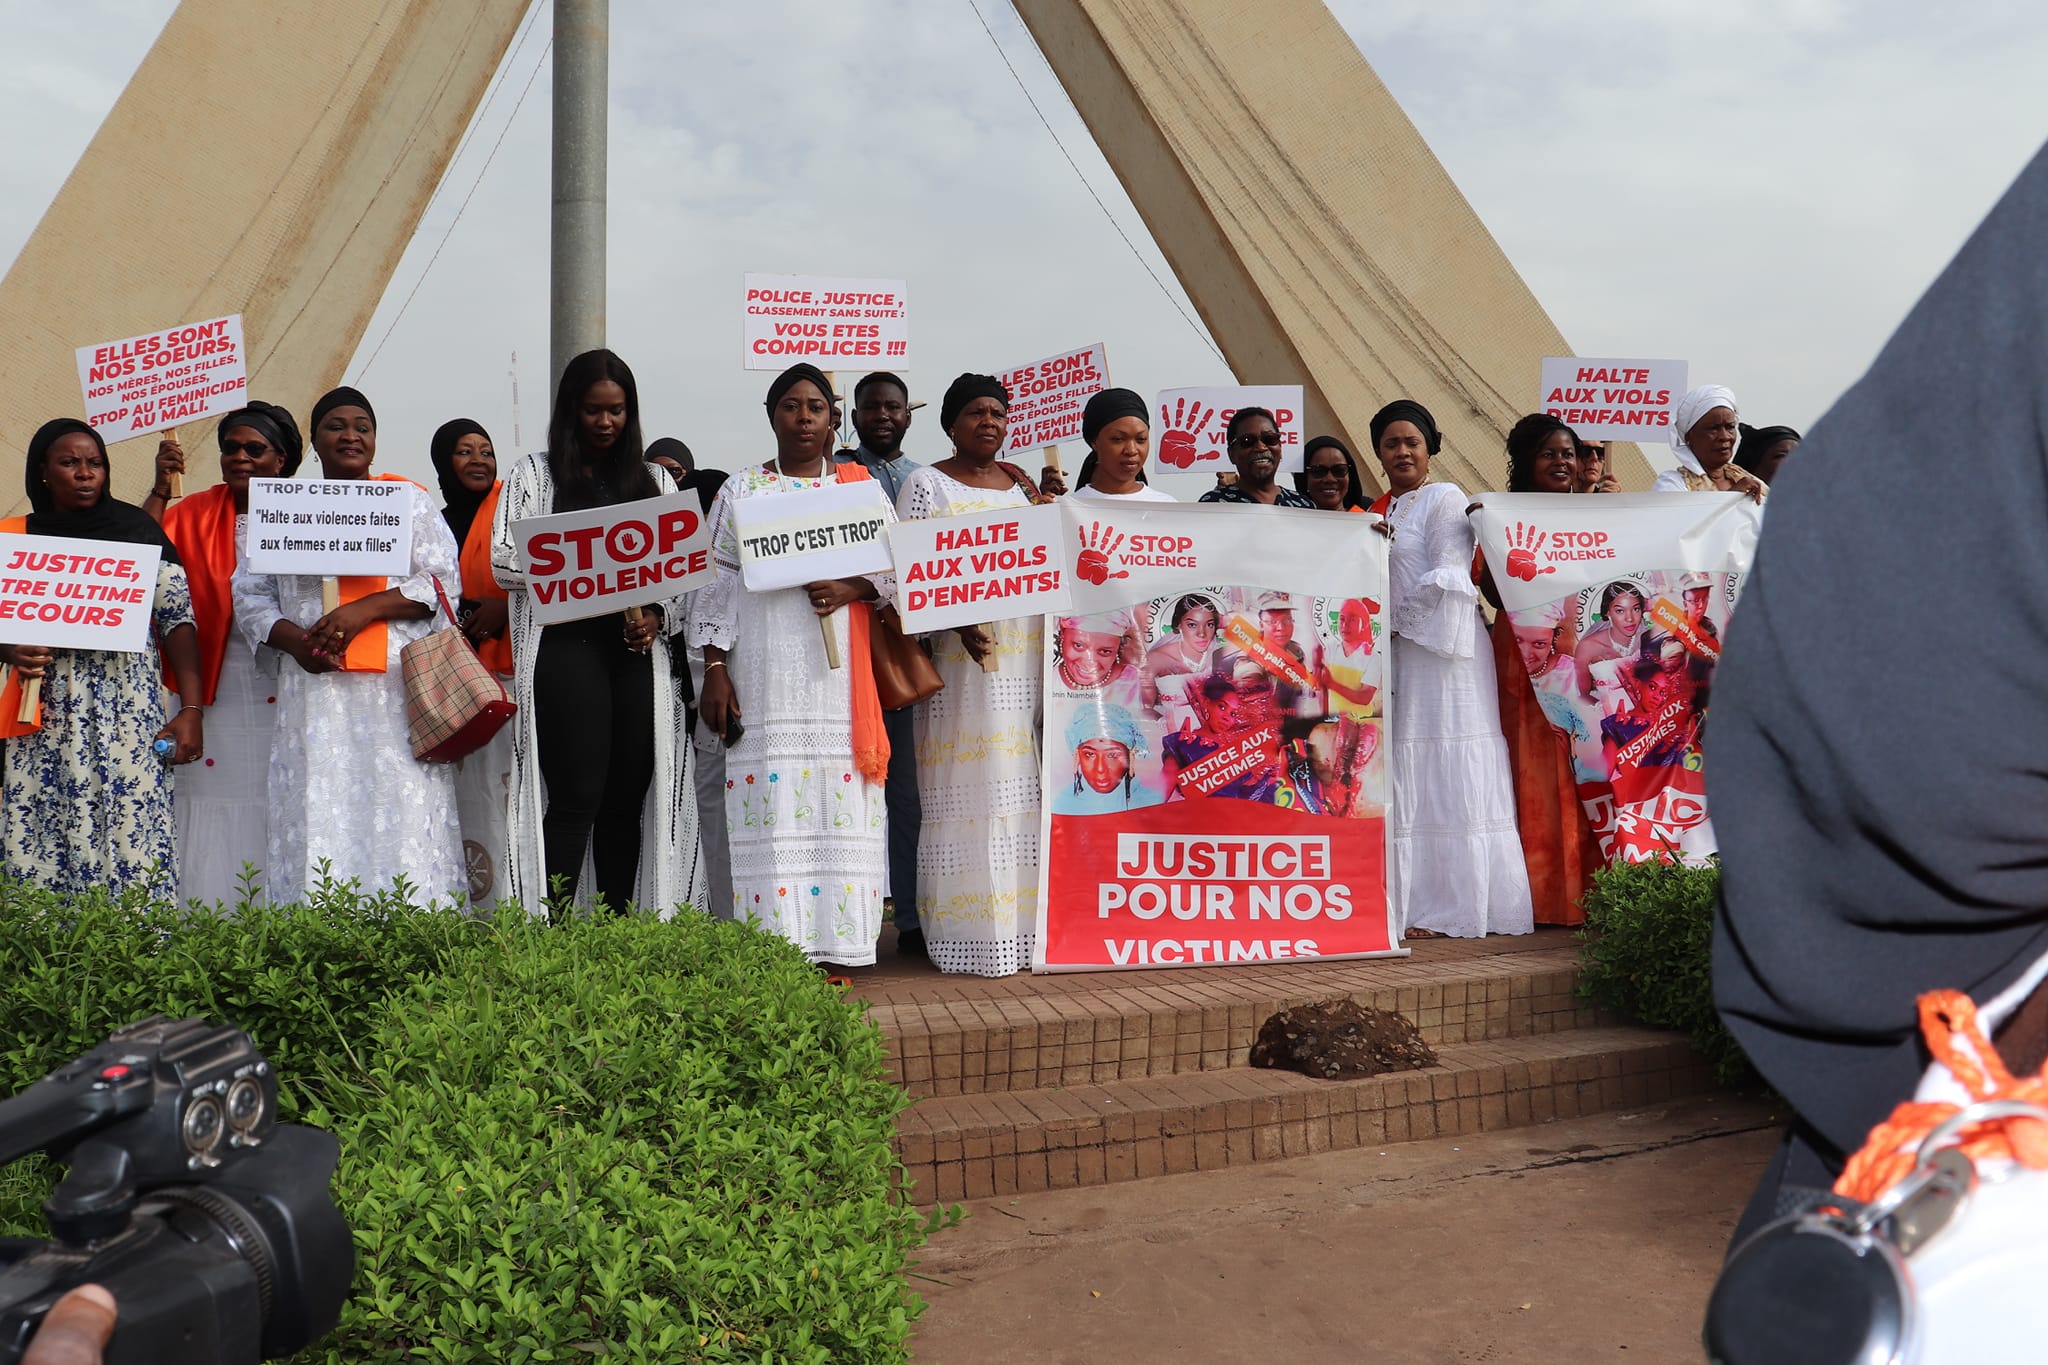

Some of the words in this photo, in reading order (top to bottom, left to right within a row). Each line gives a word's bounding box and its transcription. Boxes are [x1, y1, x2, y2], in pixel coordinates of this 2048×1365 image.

[747, 289, 812, 303] POLICE
[823, 292, 894, 305] JUSTICE
[748, 306, 826, 316] CLASSEMENT
[829, 309, 861, 317] SANS
[864, 309, 898, 318] SUITE
[95, 336, 160, 365] ELLES
[167, 320, 228, 348] SONT
[775, 323, 827, 337] VOUS
[833, 325, 879, 338] ETES
[89, 359, 135, 383] NOS
[142, 336, 236, 370] SOEURS,
[753, 339, 880, 355] COMPLICES
[88, 385, 114, 399] NOS
[117, 374, 162, 392] MÈRES,
[165, 366, 191, 380] NOS
[195, 355, 237, 372] FILLES,
[1003, 367, 1035, 387] LES
[1041, 351, 1093, 377] SONT
[1020, 365, 1101, 398] SOEURS,
[1576, 368, 1649, 383] HALTE
[122, 390, 146, 403] NOS
[151, 374, 210, 395] ÉPOUSES,
[1040, 393, 1062, 405] NOS
[1547, 388, 1597, 403] AUX
[1603, 389, 1670, 405] VIOLS
[90, 408, 128, 428] STOP
[132, 400, 154, 417] AU
[158, 377, 246, 409] FEMINICIDE
[131, 413, 156, 430] AU
[161, 400, 208, 422] MALI.
[1028, 401, 1080, 419] ÉPOUSES,
[1010, 435, 1032, 449] AU
[1037, 424, 1080, 442] MALI.
[1012, 424, 1030, 437] AU
[309, 484, 350, 495] C'EST
[293, 515, 312, 524] aux
[316, 511, 366, 525] violences
[370, 512, 400, 526] faites
[260, 539, 280, 550] aux
[283, 536, 326, 551] femmes
[329, 539, 340, 551] et
[343, 541, 362, 551] aux
[527, 509, 699, 576] STOP
[795, 526, 834, 551] C'EST
[936, 522, 1019, 551] HALTE
[1130, 535, 1192, 553] STOP
[1552, 532, 1608, 548] STOP
[6, 551, 140, 582] JUSTICE,
[906, 557, 963, 583] AUX
[971, 545, 1047, 573] VIOLS
[1119, 554, 1196, 568] VIOLENCE
[1544, 548, 1616, 561] VIOLENCE
[532, 550, 707, 605] VIOLENCE
[1, 578, 48, 596] TRE
[54, 583, 146, 604] ULTIME
[908, 571, 1060, 611] D'ENFANTS!
[0, 600, 125, 627] ECOURS
[1178, 747, 1239, 786] JUSTICE
[1241, 728, 1272, 753] AUX
[1195, 750, 1265, 793] VICTIMES
[1121, 842, 1324, 877] JUSTICE
[1098, 883, 1235, 920] POUR
[1250, 884, 1352, 921] NOS
